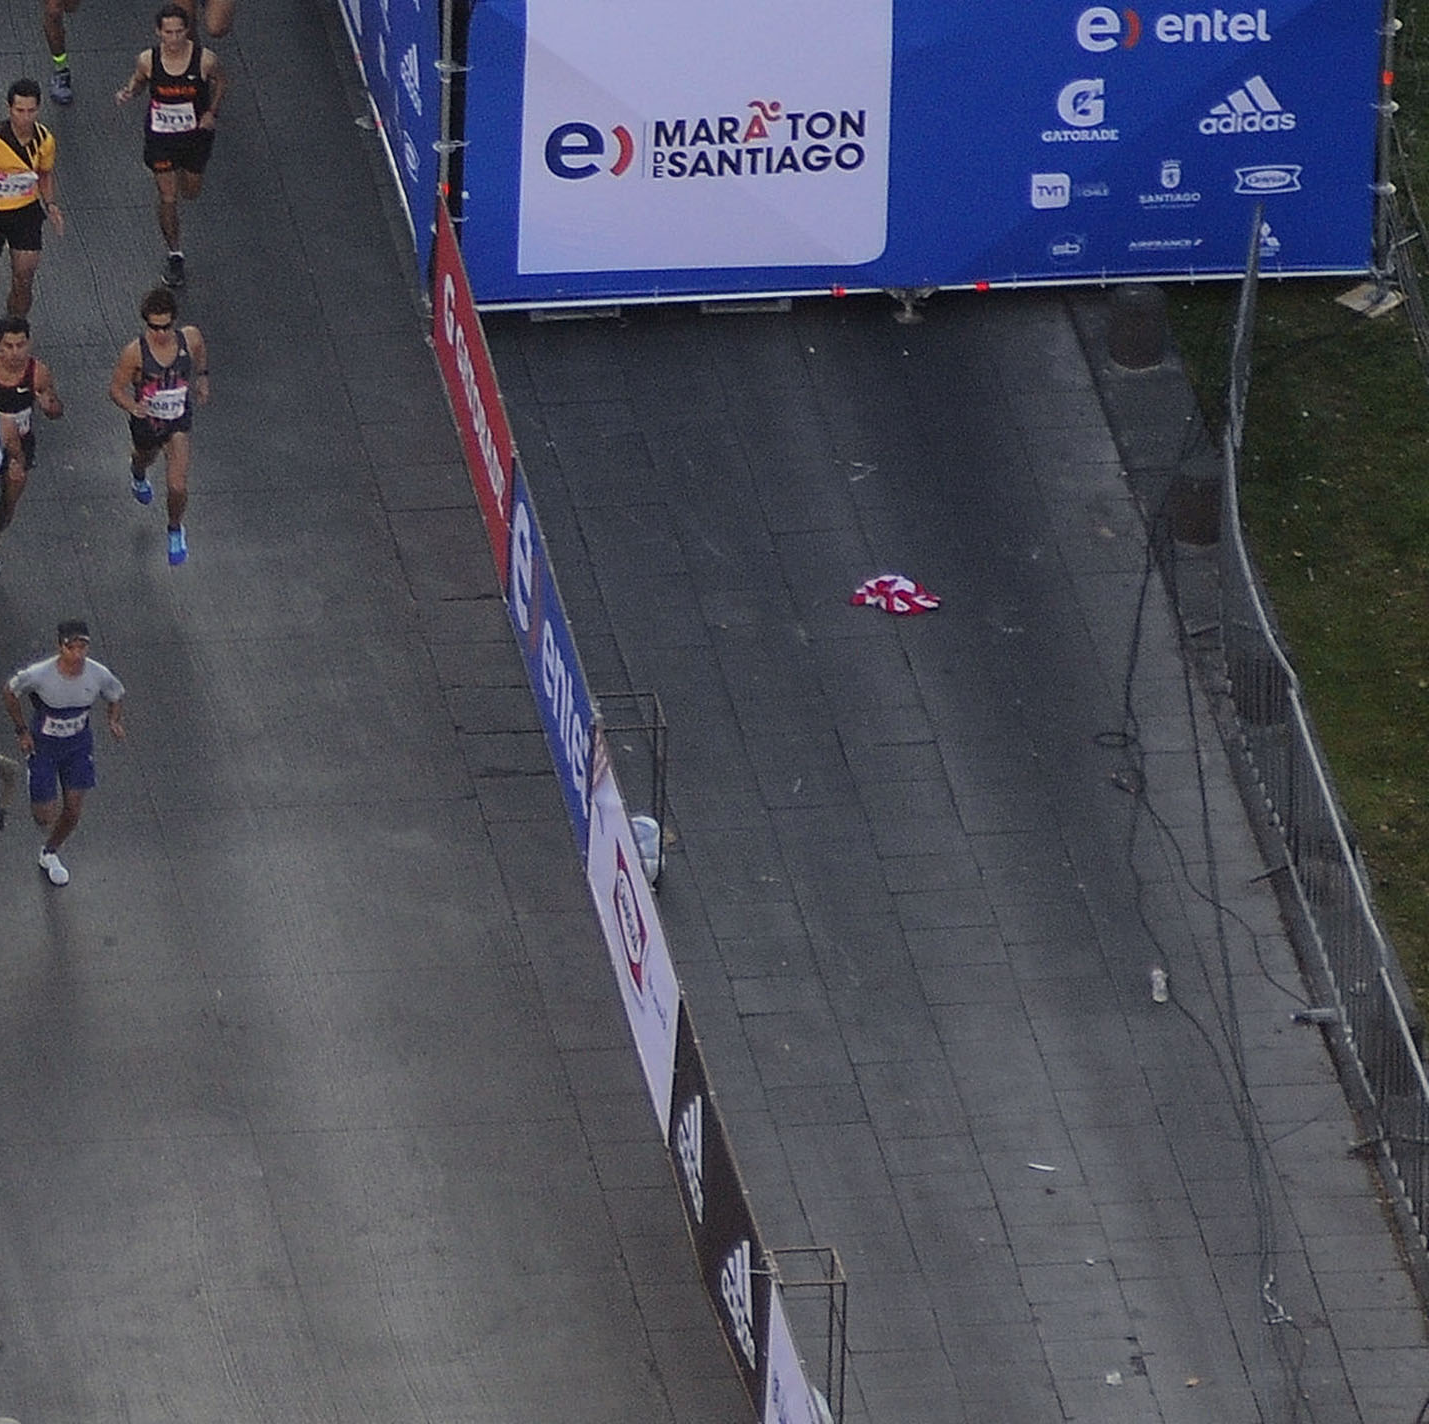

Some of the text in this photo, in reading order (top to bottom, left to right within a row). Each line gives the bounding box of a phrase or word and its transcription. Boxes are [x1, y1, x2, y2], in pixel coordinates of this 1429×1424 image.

[1155, 9, 1272, 42] entel
[1042, 130, 1120, 142] GATORADE
[1199, 111, 1297, 136] adidas
[667, 142, 866, 178] SANTIAGO
[542, 619, 590, 820] entel
